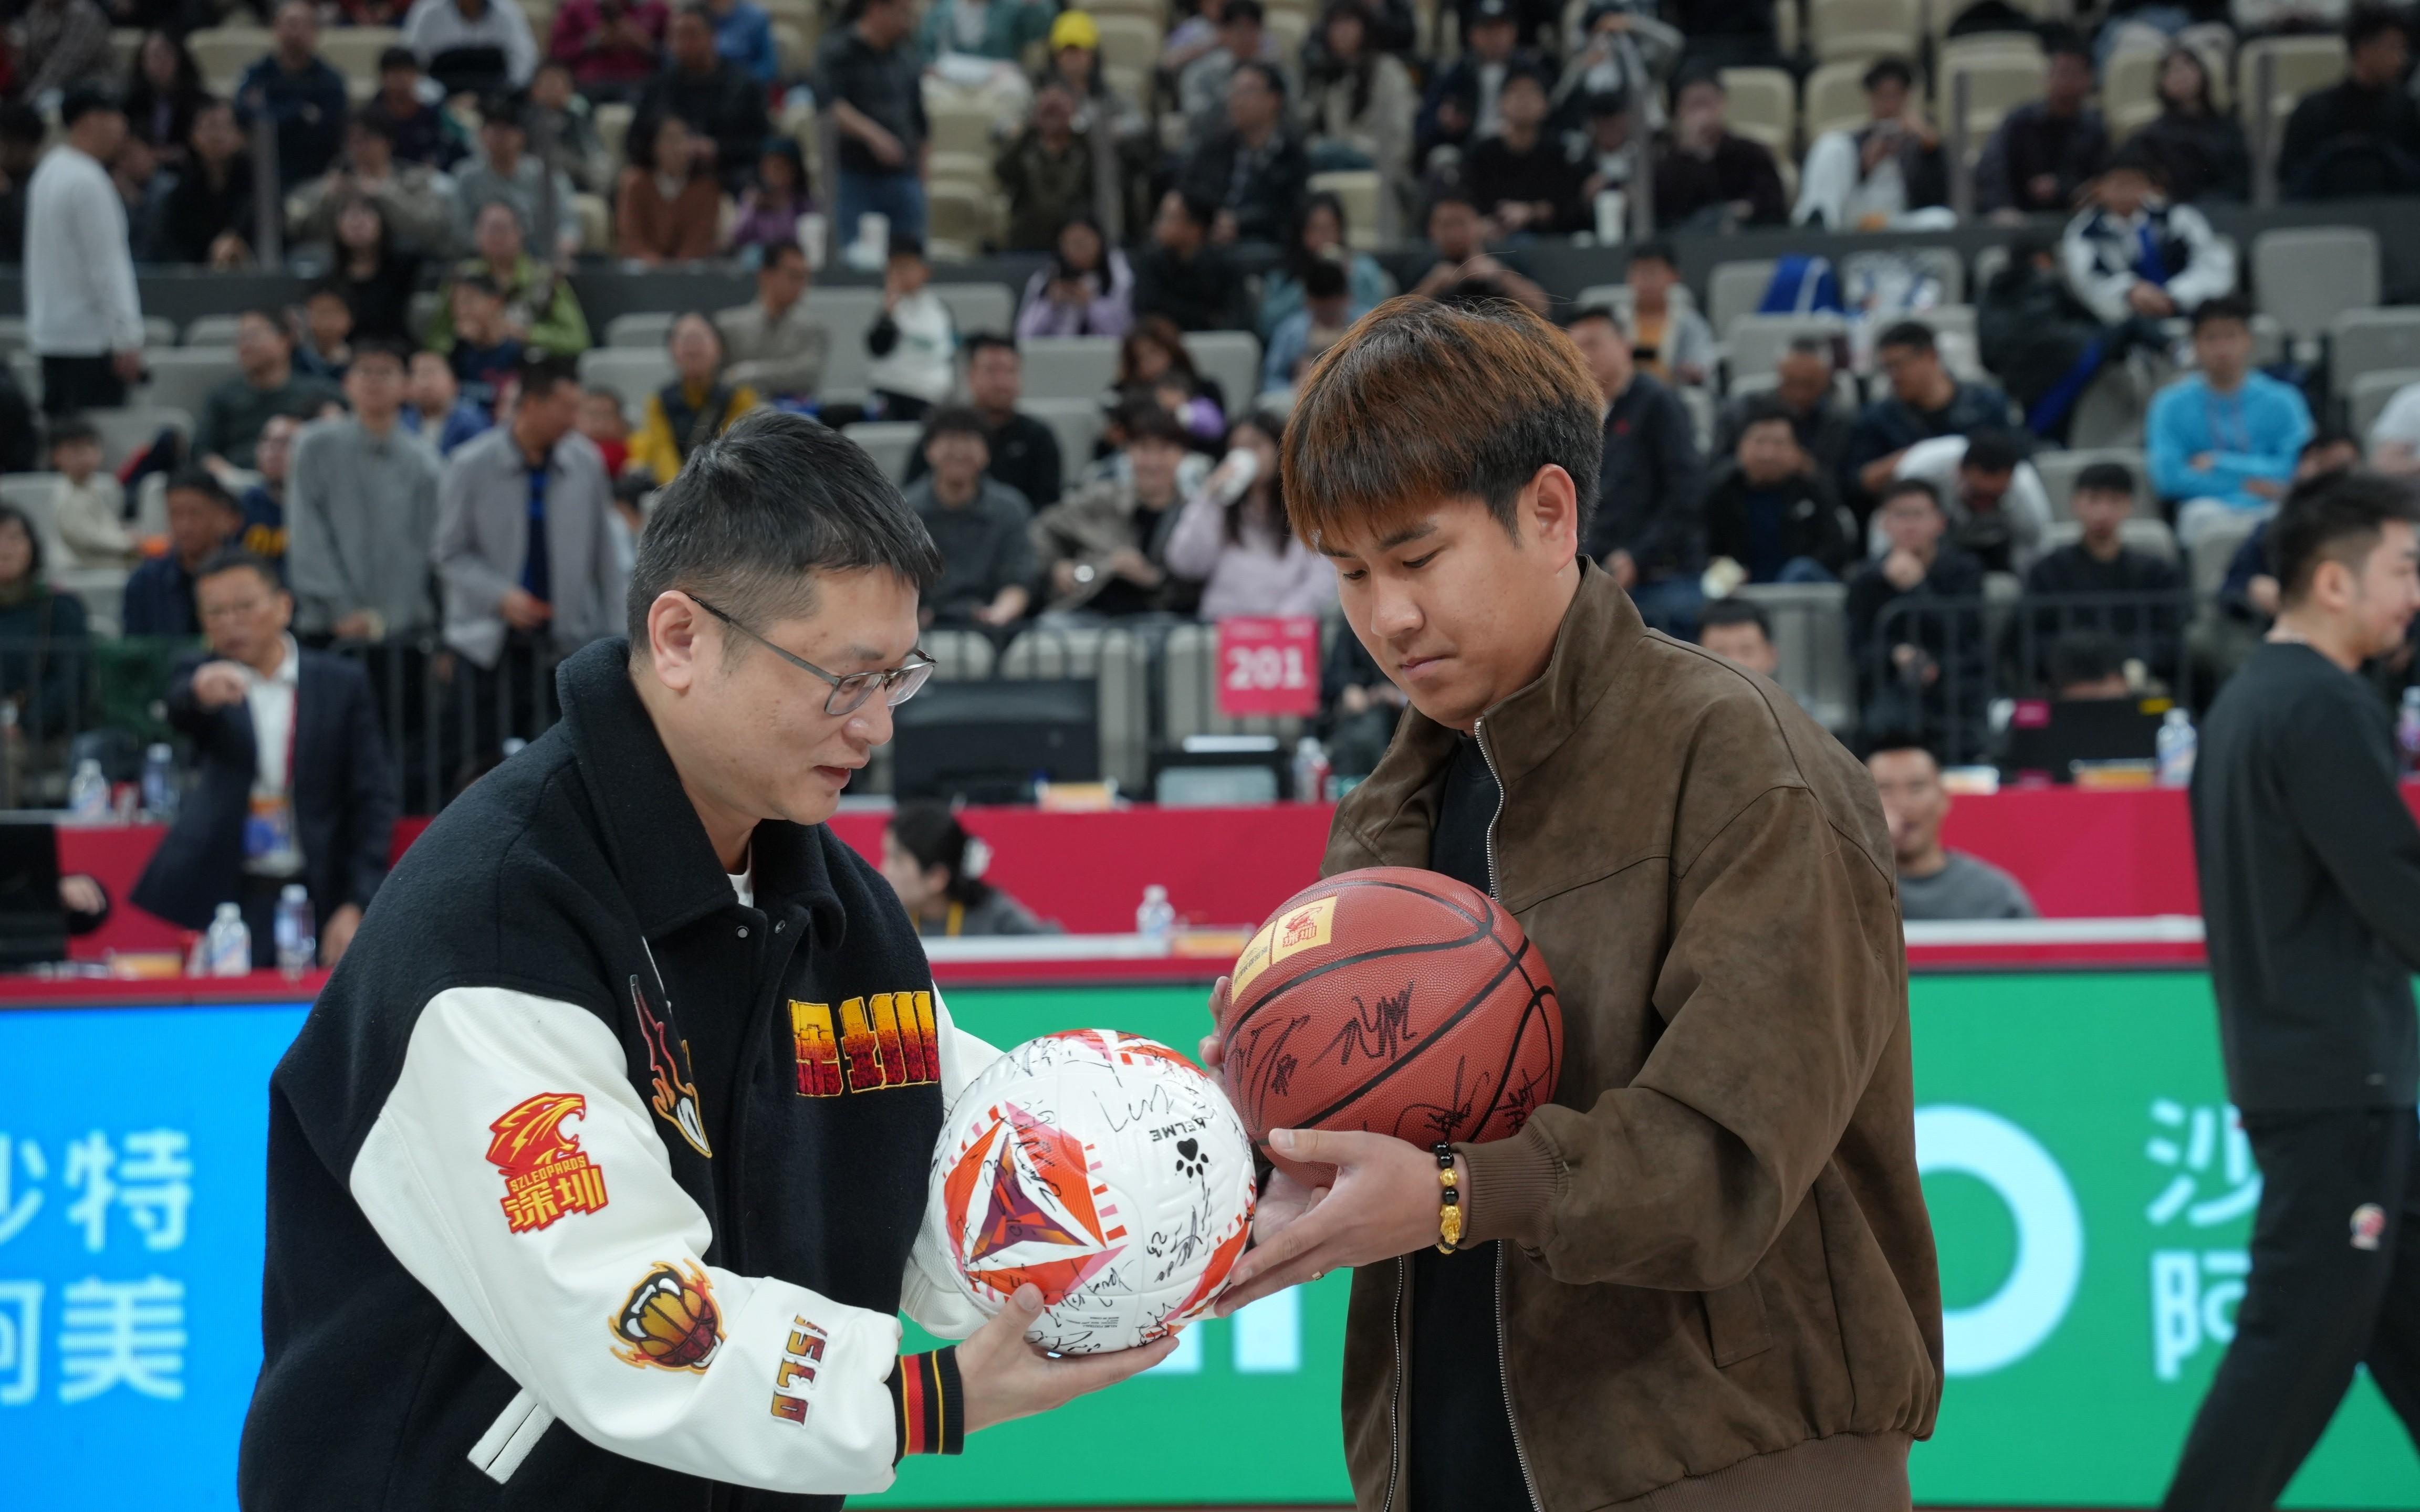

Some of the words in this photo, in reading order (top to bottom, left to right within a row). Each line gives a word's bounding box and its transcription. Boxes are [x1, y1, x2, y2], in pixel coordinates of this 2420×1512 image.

[1226, 646, 1305, 690] 201
[1149, 1117, 1206, 1142] KELME
[508, 1155, 587, 1192] SZLEOPARDS
[504, 1167, 606, 1228] 深圳
